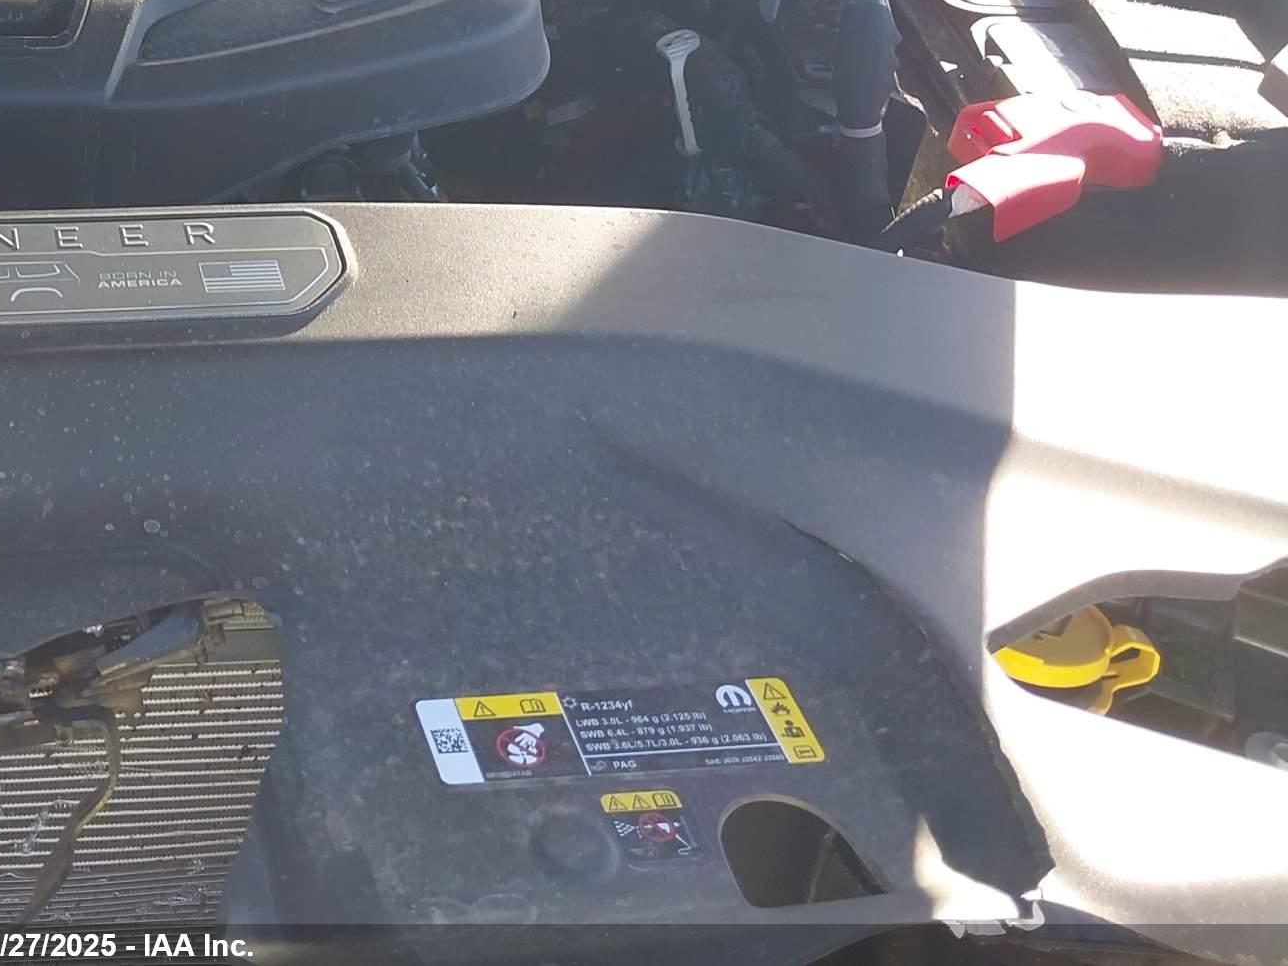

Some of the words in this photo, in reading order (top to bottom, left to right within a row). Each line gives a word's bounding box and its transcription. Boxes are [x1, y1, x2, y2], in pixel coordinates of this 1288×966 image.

[98, 278, 183, 289] AMERICA
[580, 699, 633, 712] R-1234yf
[575, 717, 600, 727] LWB
[579, 729, 605, 739] SWB
[585, 742, 611, 752] SWB
[613, 760, 637, 770] PAG
